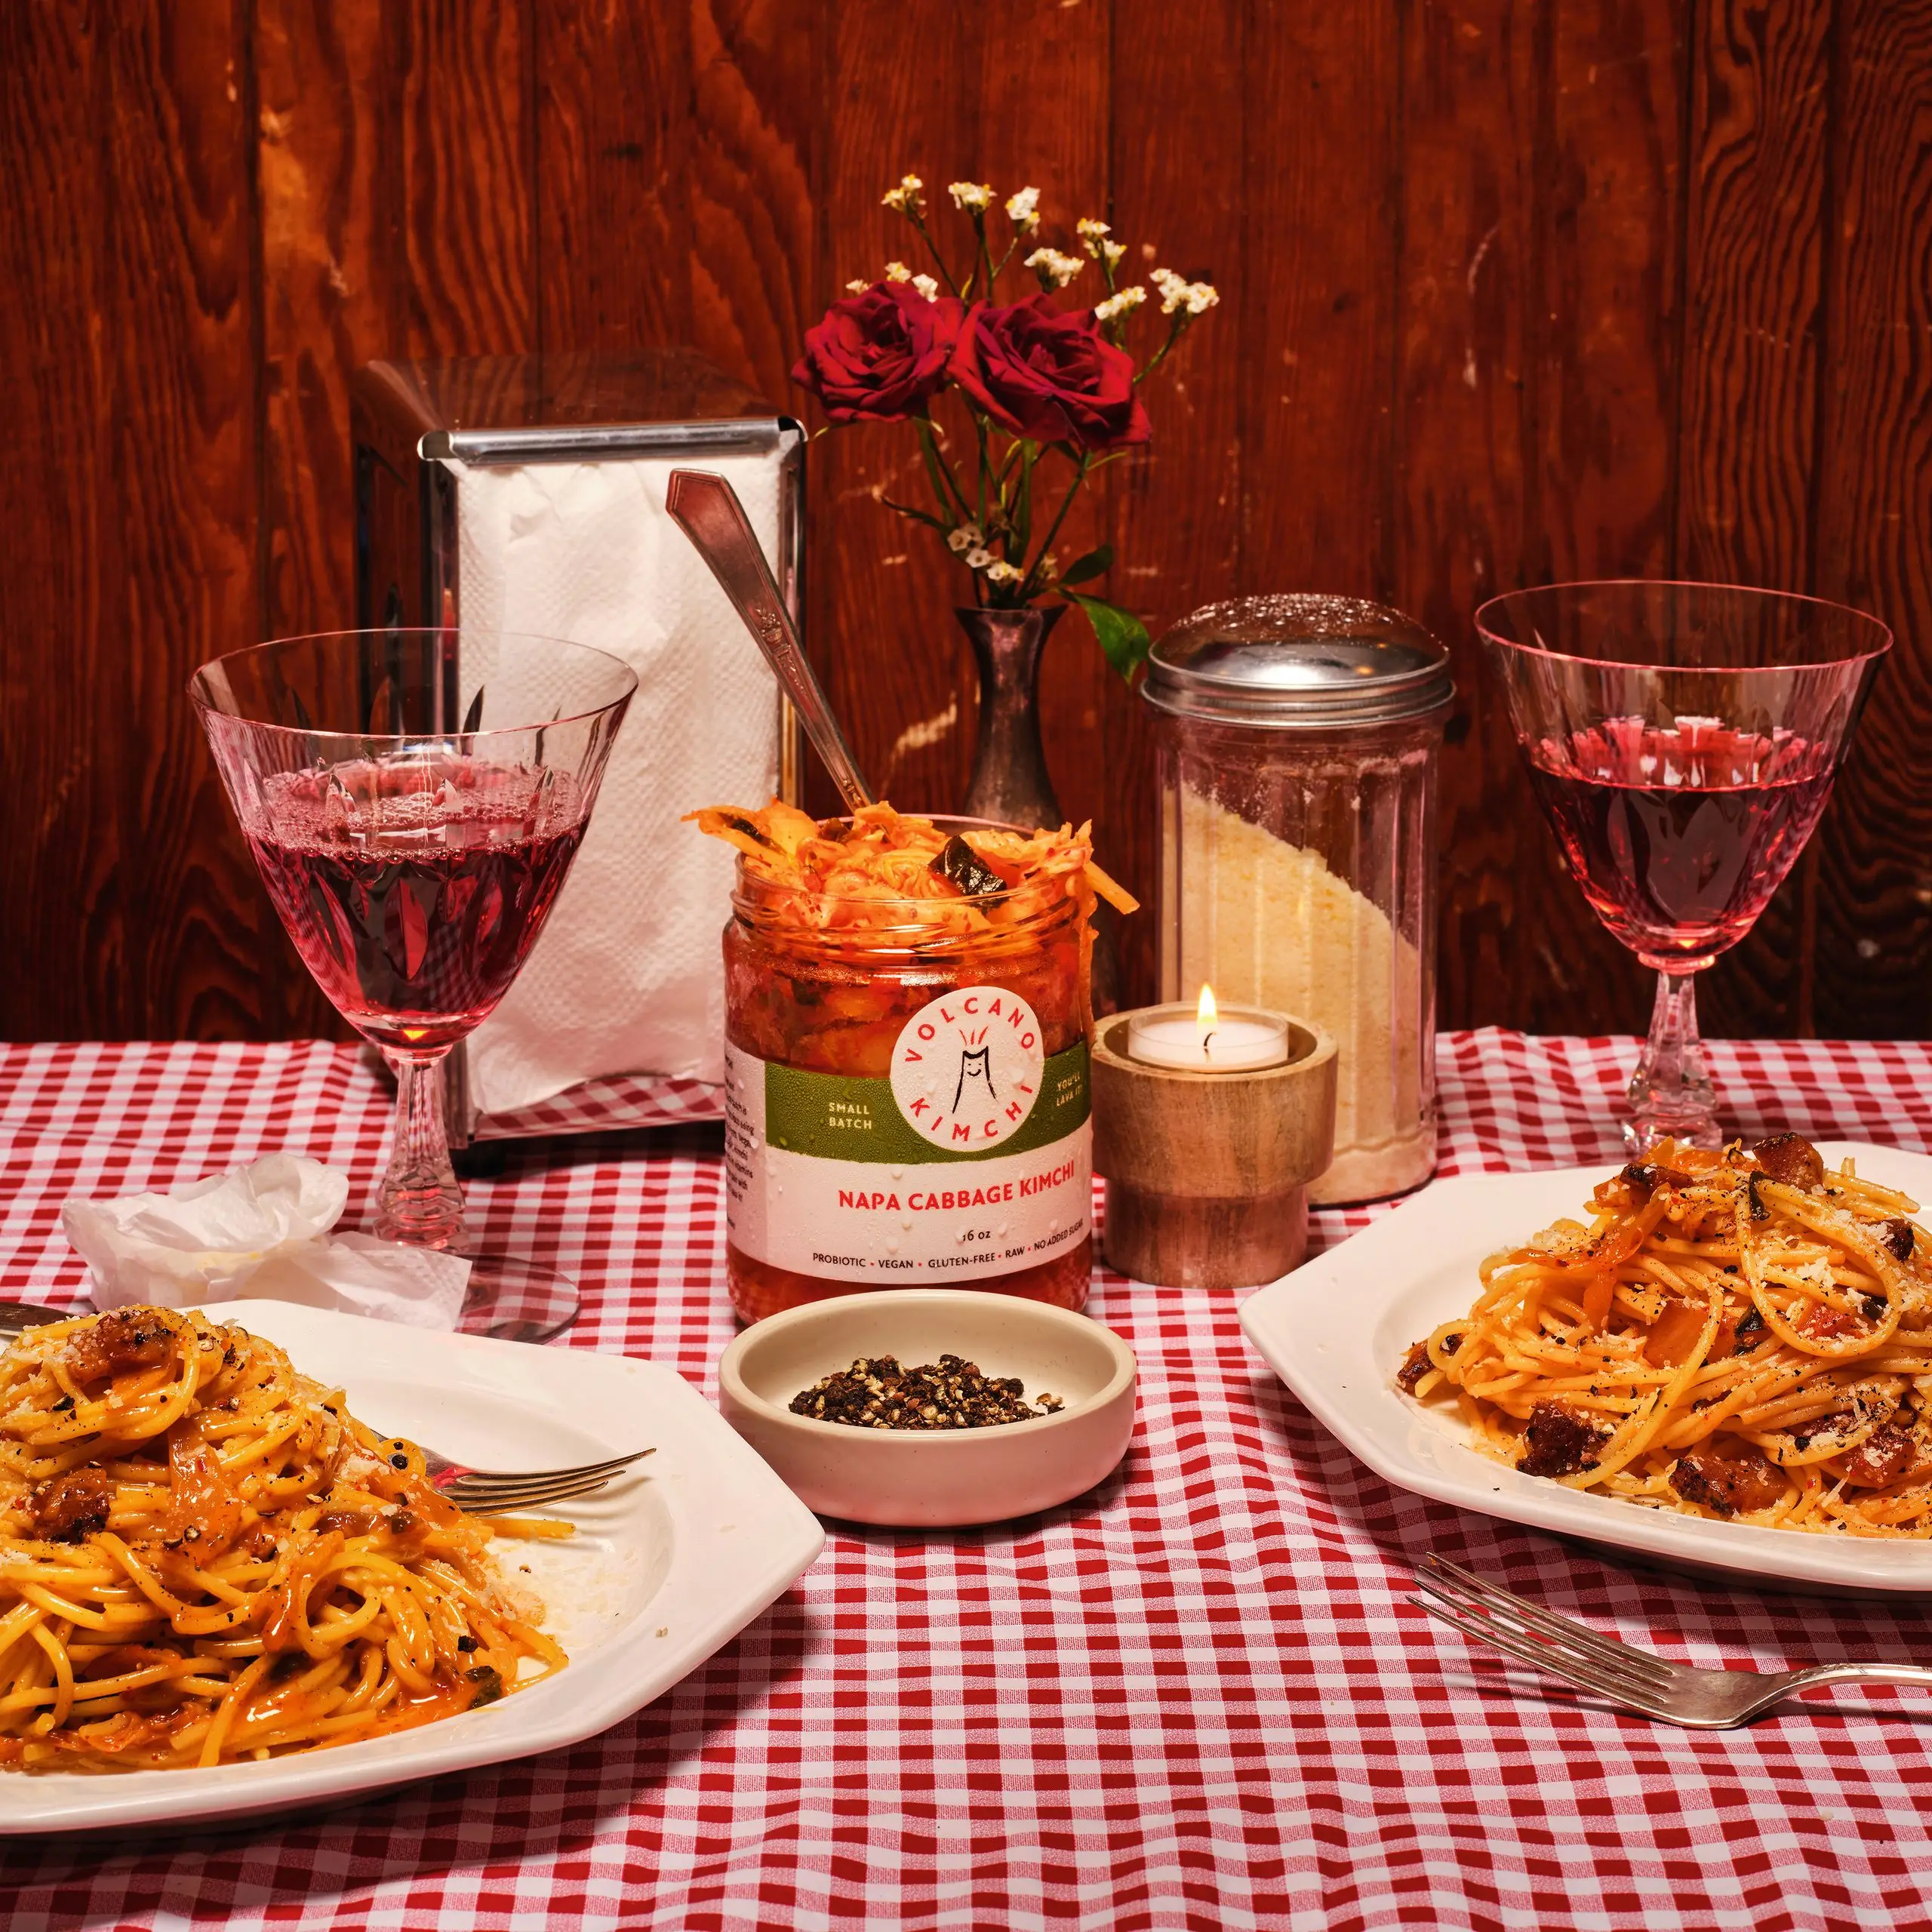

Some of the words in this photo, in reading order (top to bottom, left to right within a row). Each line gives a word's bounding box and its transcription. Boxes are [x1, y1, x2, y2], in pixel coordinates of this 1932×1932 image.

[905, 997, 1035, 1062] VOLCANO
[829, 1102, 869, 1115] SMALL
[829, 1117, 872, 1129] BATCH
[909, 1085, 1033, 1142] KIMCHI
[838, 1190, 901, 1211] NAPA
[908, 1183, 1013, 1211] CABBAGE
[1020, 1160, 1075, 1198] KIMCHI
[813, 1253, 866, 1267] PROBIOTIC
[878, 1260, 913, 1269] VEGAN
[928, 1252, 995, 1269] GLUTEN-FREE
[1005, 1246, 1025, 1259] RAW
[1034, 1240, 1045, 1251] NO
[1047, 1229, 1069, 1247] ADDED
[1069, 1218, 1084, 1236] SUGAR
[962, 1229, 974, 1241] 16
[978, 1230, 991, 1240] oz
